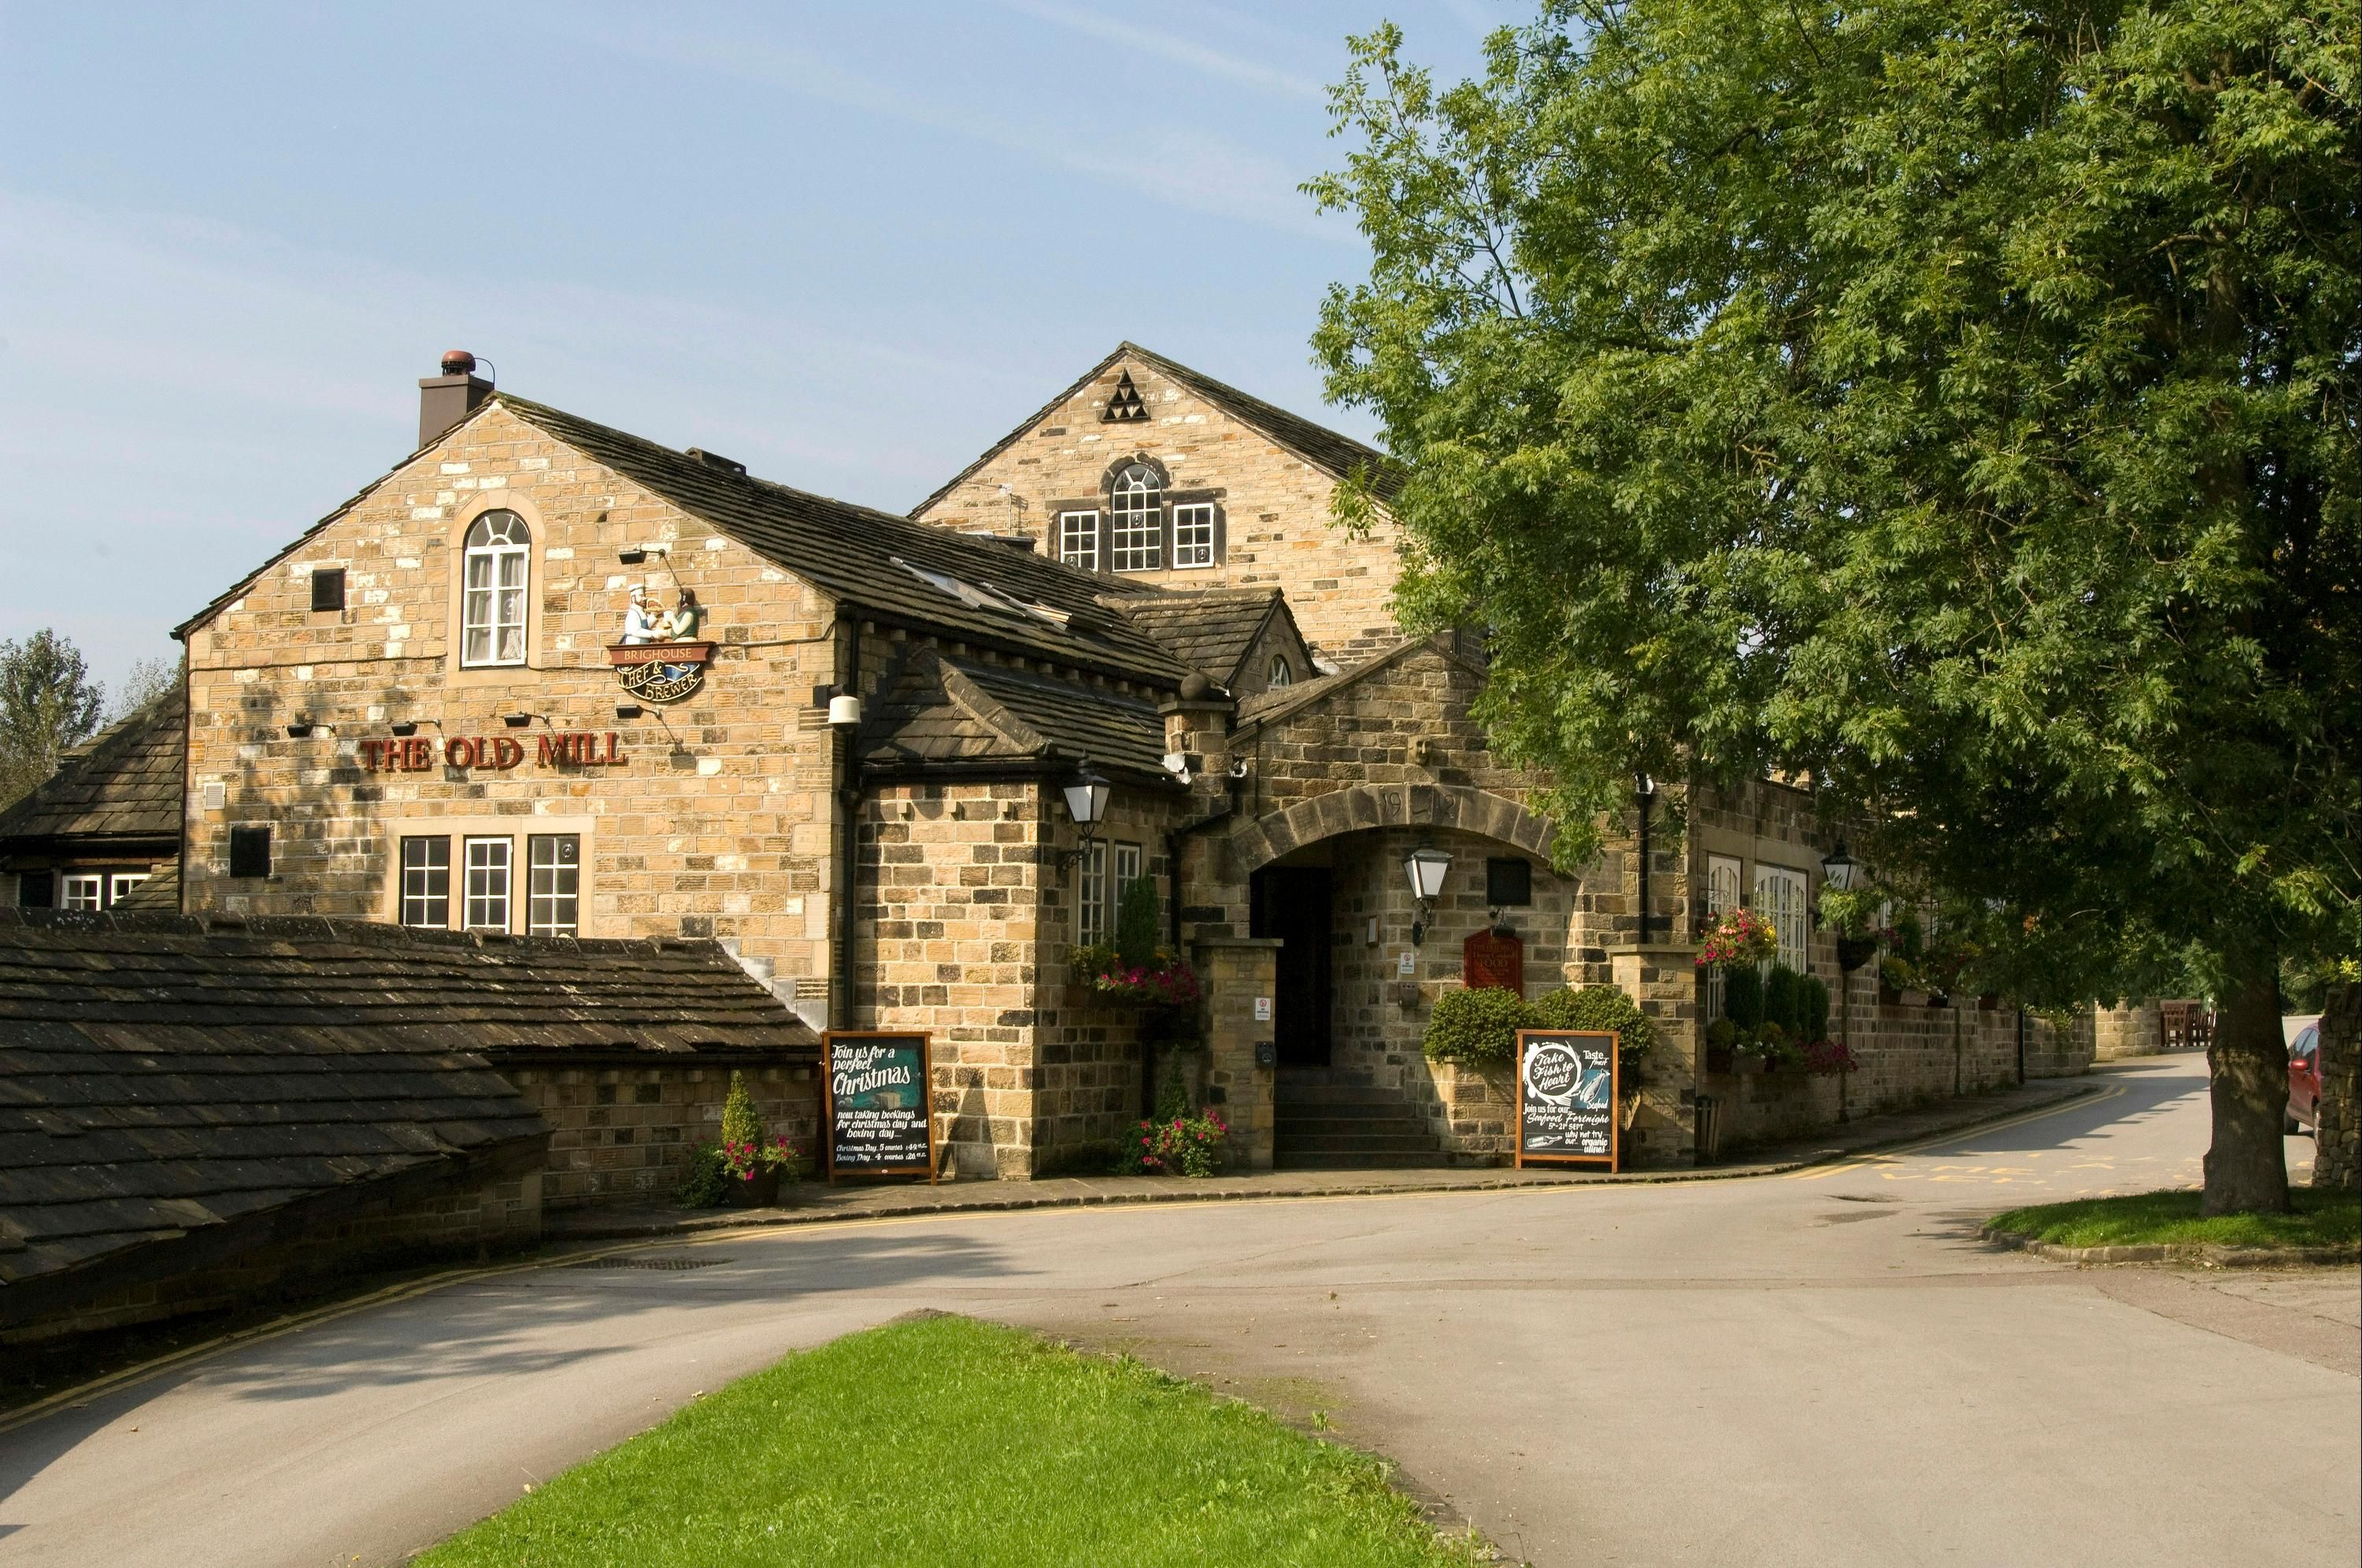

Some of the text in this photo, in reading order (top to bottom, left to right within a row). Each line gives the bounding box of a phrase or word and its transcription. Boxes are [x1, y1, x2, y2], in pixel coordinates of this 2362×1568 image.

[624, 648, 692, 660] BRIGHOUSE
[619, 661, 661, 688] CHEF &
[645, 675, 697, 700] BREWER
[361, 732, 626, 770] THE OLD MILL
[831, 1045, 895, 1060] Join us for a
[1535, 1052, 1564, 1067] Take
[832, 1059, 872, 1073] perfect
[1533, 1061, 1575, 1079] Fish to
[833, 1066, 910, 1095] Christmas
[1538, 1074, 1570, 1091] Heart
[855, 1110, 879, 1121] taking
[881, 1110, 916, 1121] bookings
[1523, 1103, 1537, 1115] Join
[1547, 1104, 1557, 1113] for
[835, 1119, 927, 1131] for christmas day and
[1527, 1112, 1609, 1126] Seafood Fortnight
[846, 1128, 876, 1139] boxing
[1564, 1130, 1578, 1139] why
[1592, 1130, 1603, 1139] try
[1581, 1137, 1608, 1147] organic
[1583, 1145, 1605, 1154] wines
